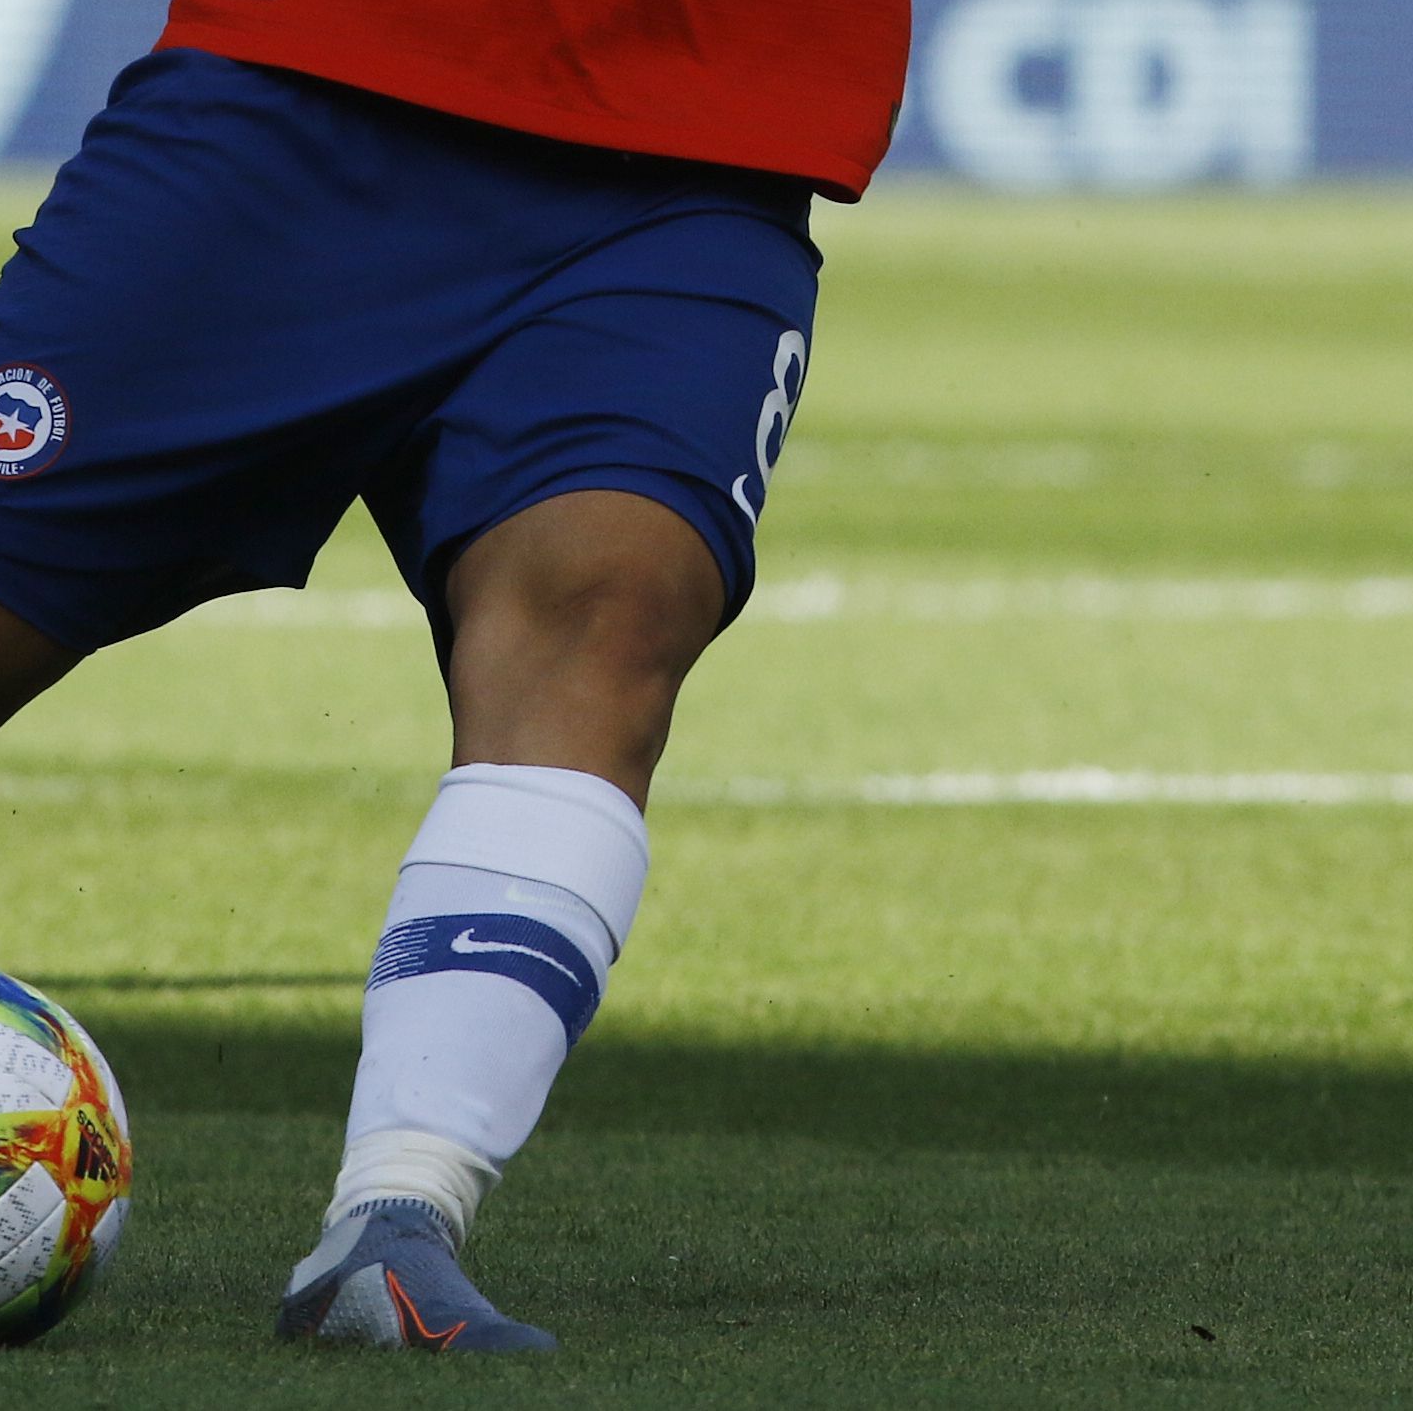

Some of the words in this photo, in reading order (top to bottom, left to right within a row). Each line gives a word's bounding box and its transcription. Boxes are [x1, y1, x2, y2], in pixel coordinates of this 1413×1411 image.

[36, 377, 54, 396] DE
[48, 395, 66, 442] FUTBOL
[756, 329, 806, 489] 8
